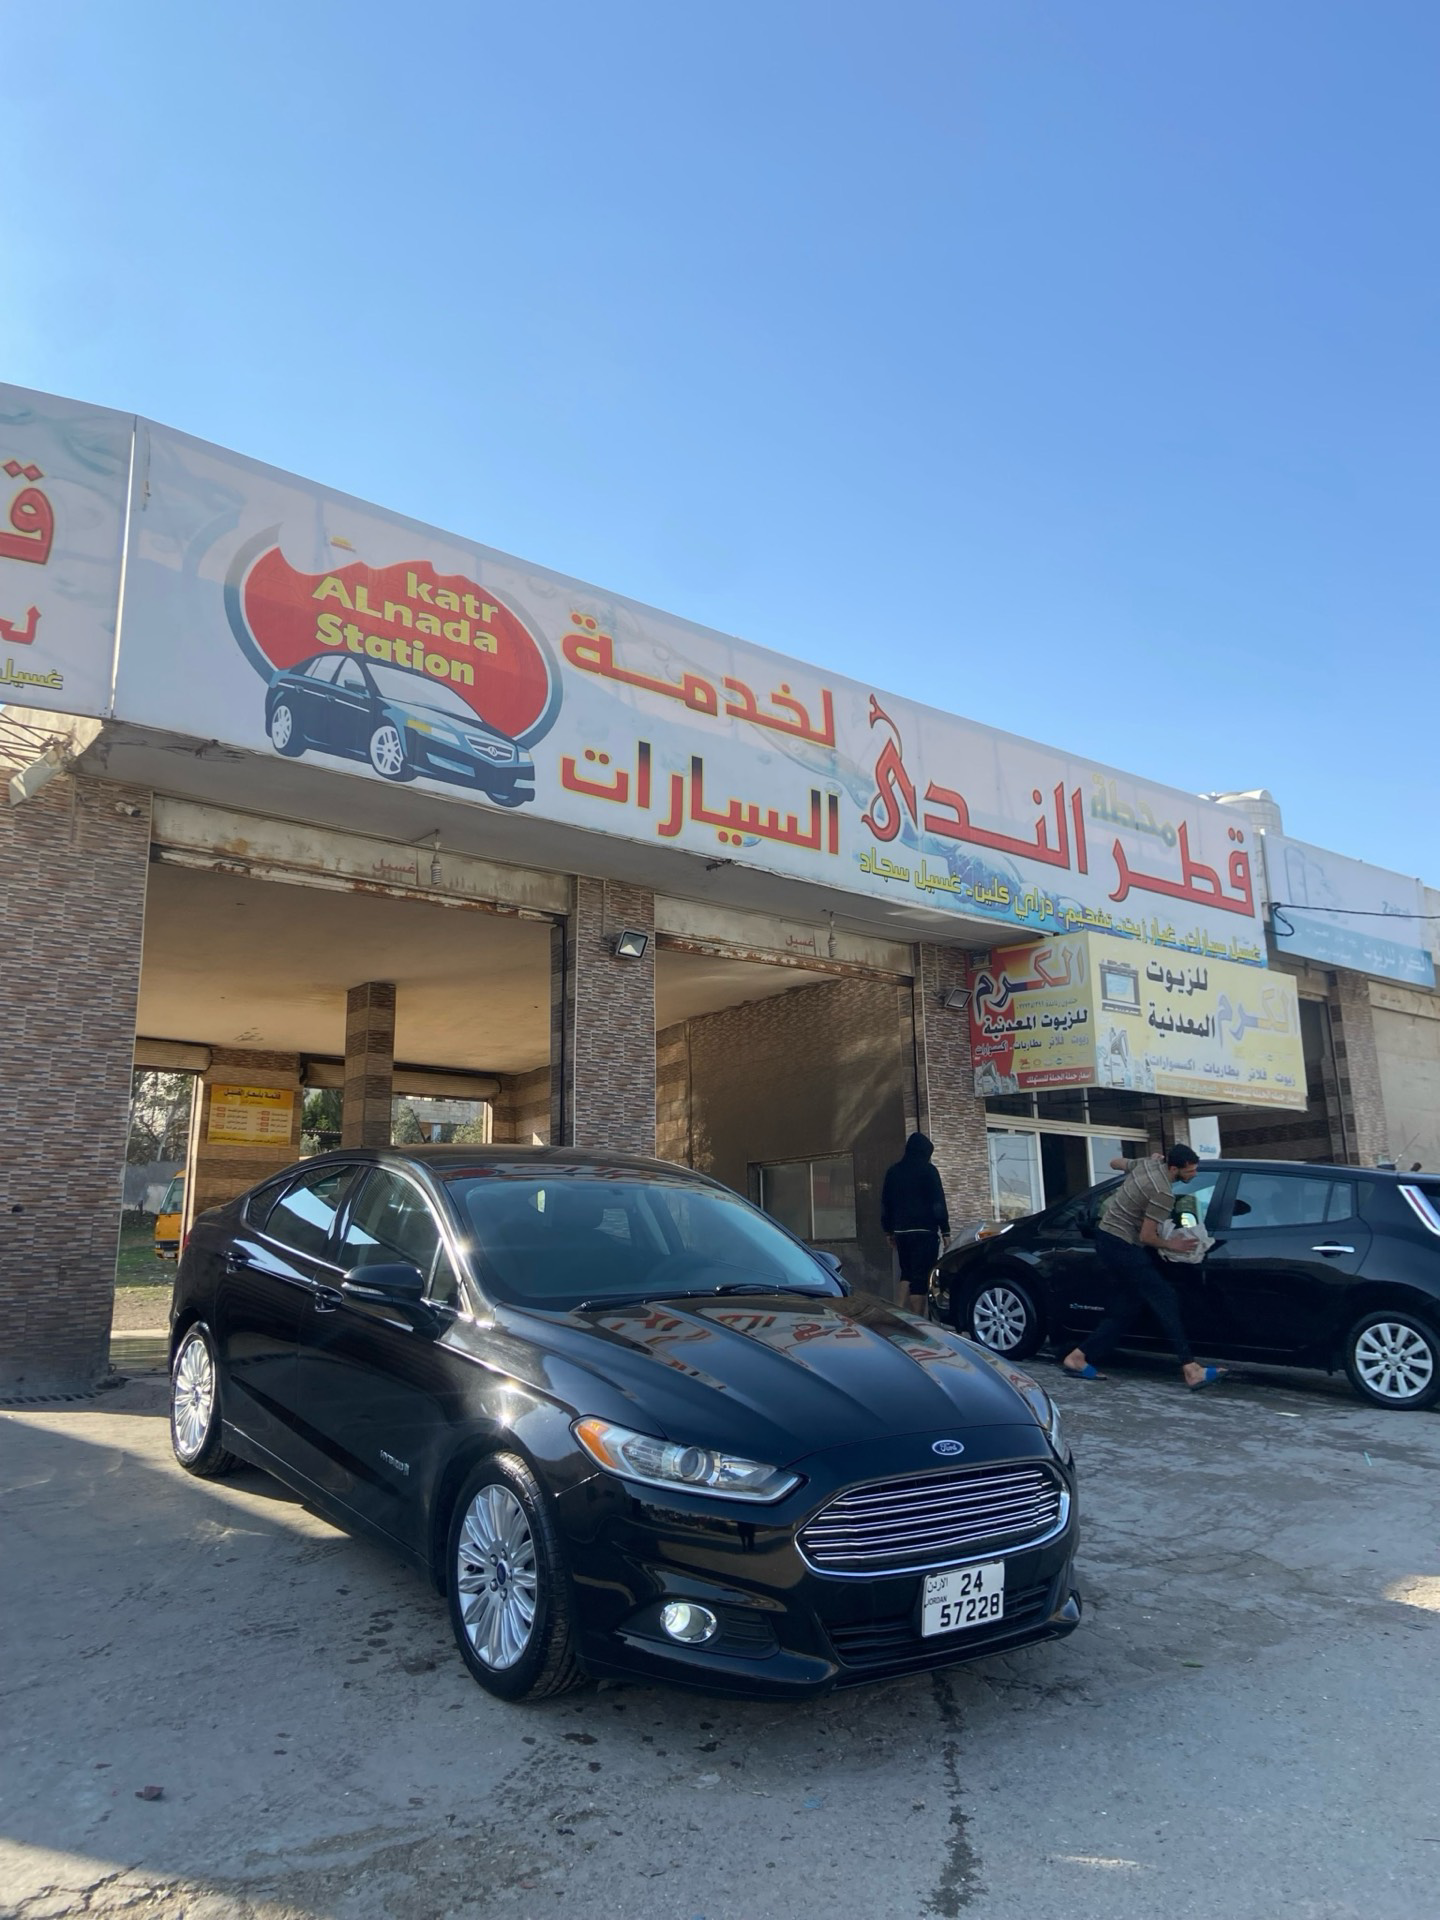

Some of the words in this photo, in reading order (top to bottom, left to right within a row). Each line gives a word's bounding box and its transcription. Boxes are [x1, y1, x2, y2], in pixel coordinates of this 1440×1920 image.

[312, 574, 498, 655] ALnada
[406, 571, 499, 625] katr
[315, 614, 476, 687] Station
[561, 612, 836, 749] لخدمة
[561, 740, 839, 857] السيارات
[861, 693, 1088, 875] الندى
[1091, 772, 1177, 848] محطة
[859, 847, 910, 883] سجاد
[914, 859, 962, 895] غسيل
[1109, 820, 1255, 918] قطر
[976, 944, 1085, 1021] الكرم
[1146, 961, 1208, 996] للزيوت
[983, 1015, 1037, 1039] المعدنية
[1041, 1009, 1088, 1031] للزيوت
[1148, 1002, 1216, 1039] المعدنية
[940, 1593, 1000, 1627] 57228
[960, 1570, 984, 1596] 24
